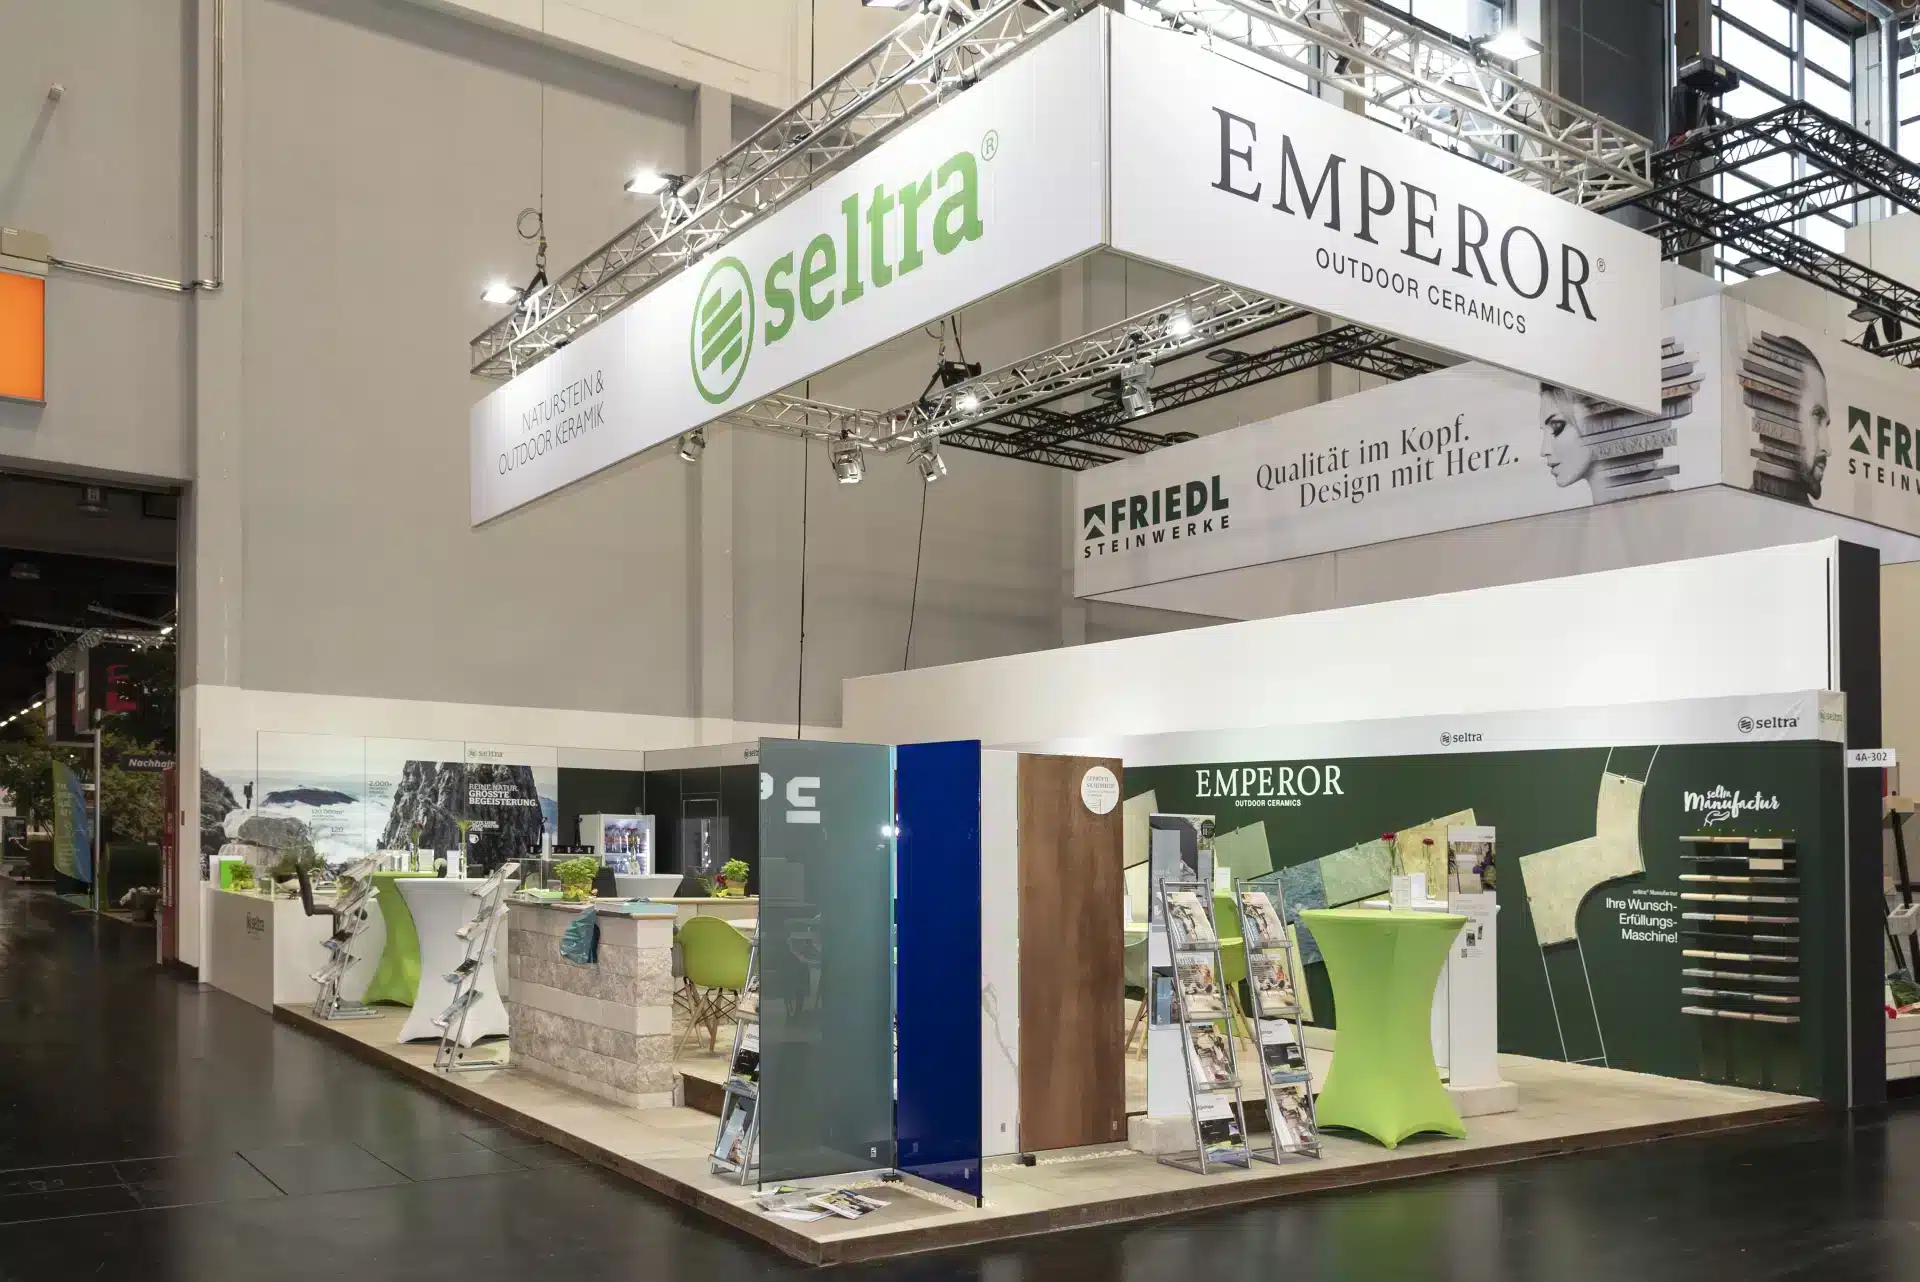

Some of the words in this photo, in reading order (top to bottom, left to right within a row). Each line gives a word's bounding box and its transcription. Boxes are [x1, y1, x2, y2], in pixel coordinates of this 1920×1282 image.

[1316, 247, 1419, 299] OUTDOOR
[1427, 285, 1526, 334] CERAMICS
[521, 374, 593, 434] NATURSTEIN
[595, 369, 604, 394] &
[498, 430, 552, 475] OUTDOOR
[555, 401, 604, 448] KERAMIK
[1256, 446, 1350, 491] Qualität
[1359, 439, 1389, 465] im
[1400, 413, 1470, 456] Kopf.
[1299, 473, 1380, 508] Design
[1391, 456, 1434, 489] mit
[1446, 444, 1519, 477] Herz.
[1111, 474, 1230, 535] FRIEDL
[1084, 515, 1230, 559] STEINWERKE
[1855, 752, 1888, 762] 4A-302
[468, 783, 492, 791] REINE
[1195, 765, 1345, 797] EMPEROR
[468, 797, 539, 807] BEGEISTERUNG.
[1267, 799, 1302, 807] CERAMICS
[1683, 790, 1781, 819] Manufactur
[1606, 897, 1626, 909] Ihre
[1627, 898, 1678, 912] Wunsch-
[1619, 913, 1678, 930] Erfüllungs-
[1621, 928, 1678, 943] Maschine!
